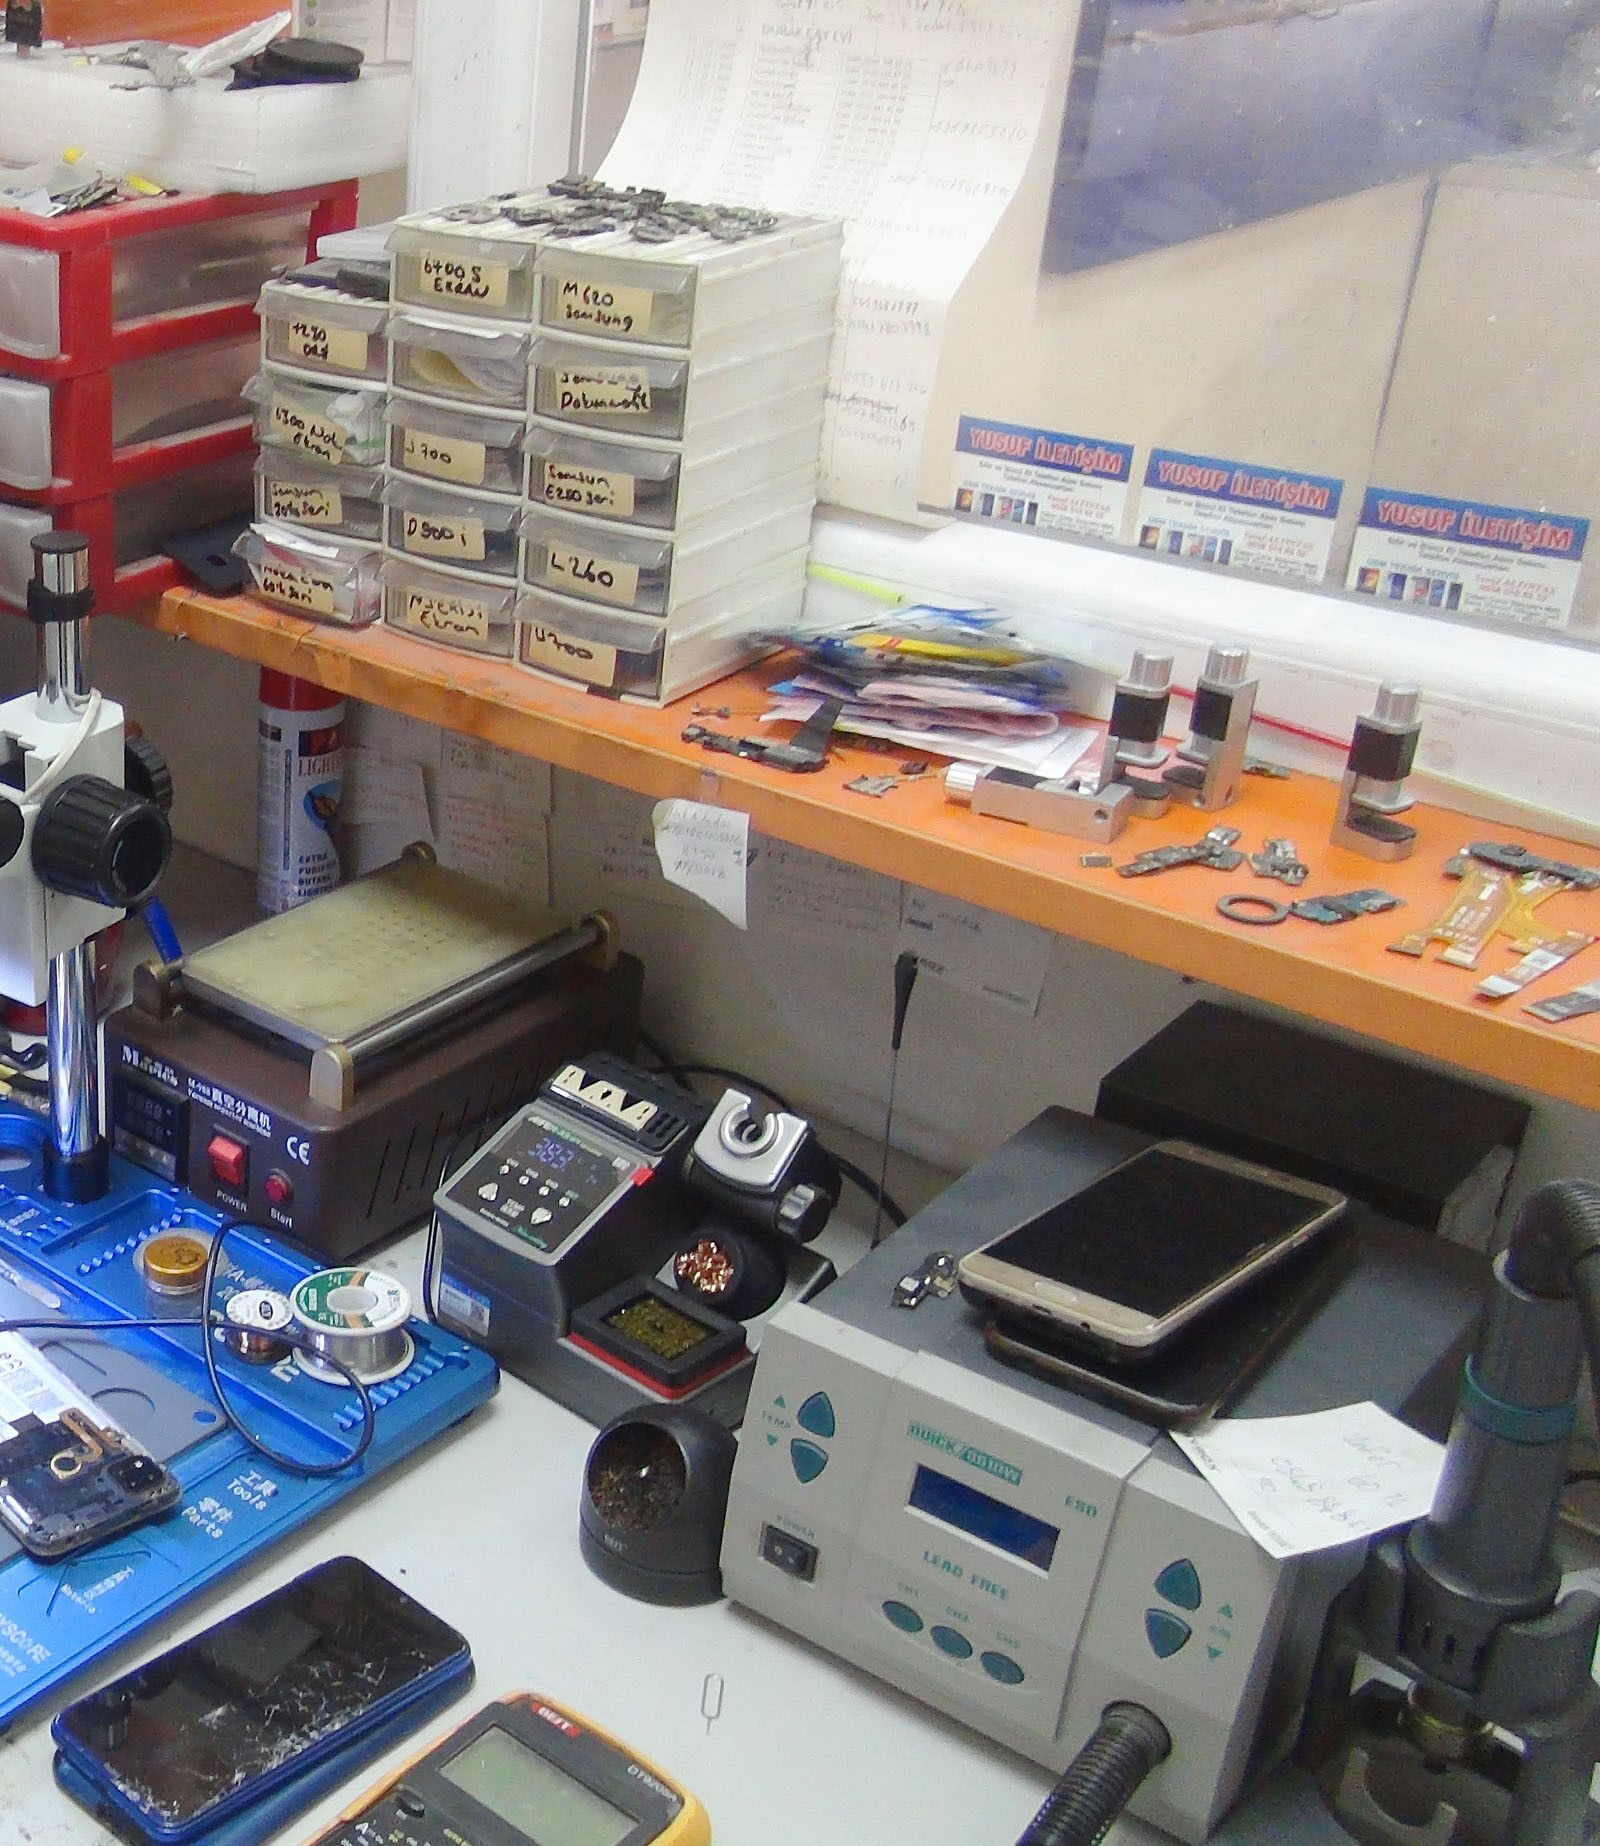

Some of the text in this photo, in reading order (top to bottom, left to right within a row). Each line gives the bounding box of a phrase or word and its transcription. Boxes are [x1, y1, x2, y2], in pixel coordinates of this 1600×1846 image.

[563, 281, 578, 297] M
[970, 427, 1123, 475] YUSUF İLETİŞİM
[1158, 460, 1331, 511] YUSUF İLETİŞİM
[1377, 498, 1574, 552] YUSUF İLETİŞİM
[550, 552, 614, 588] L 260
[286, 1135, 311, 1166] CE
[216, 1188, 248, 1213] POWER
[270, 1206, 293, 1229] Start
[226, 1477, 268, 1511] Tools
[1064, 1495, 1098, 1519] ESD
[181, 1505, 223, 1539] Parts
[922, 1550, 1009, 1600] LEAD FREE
